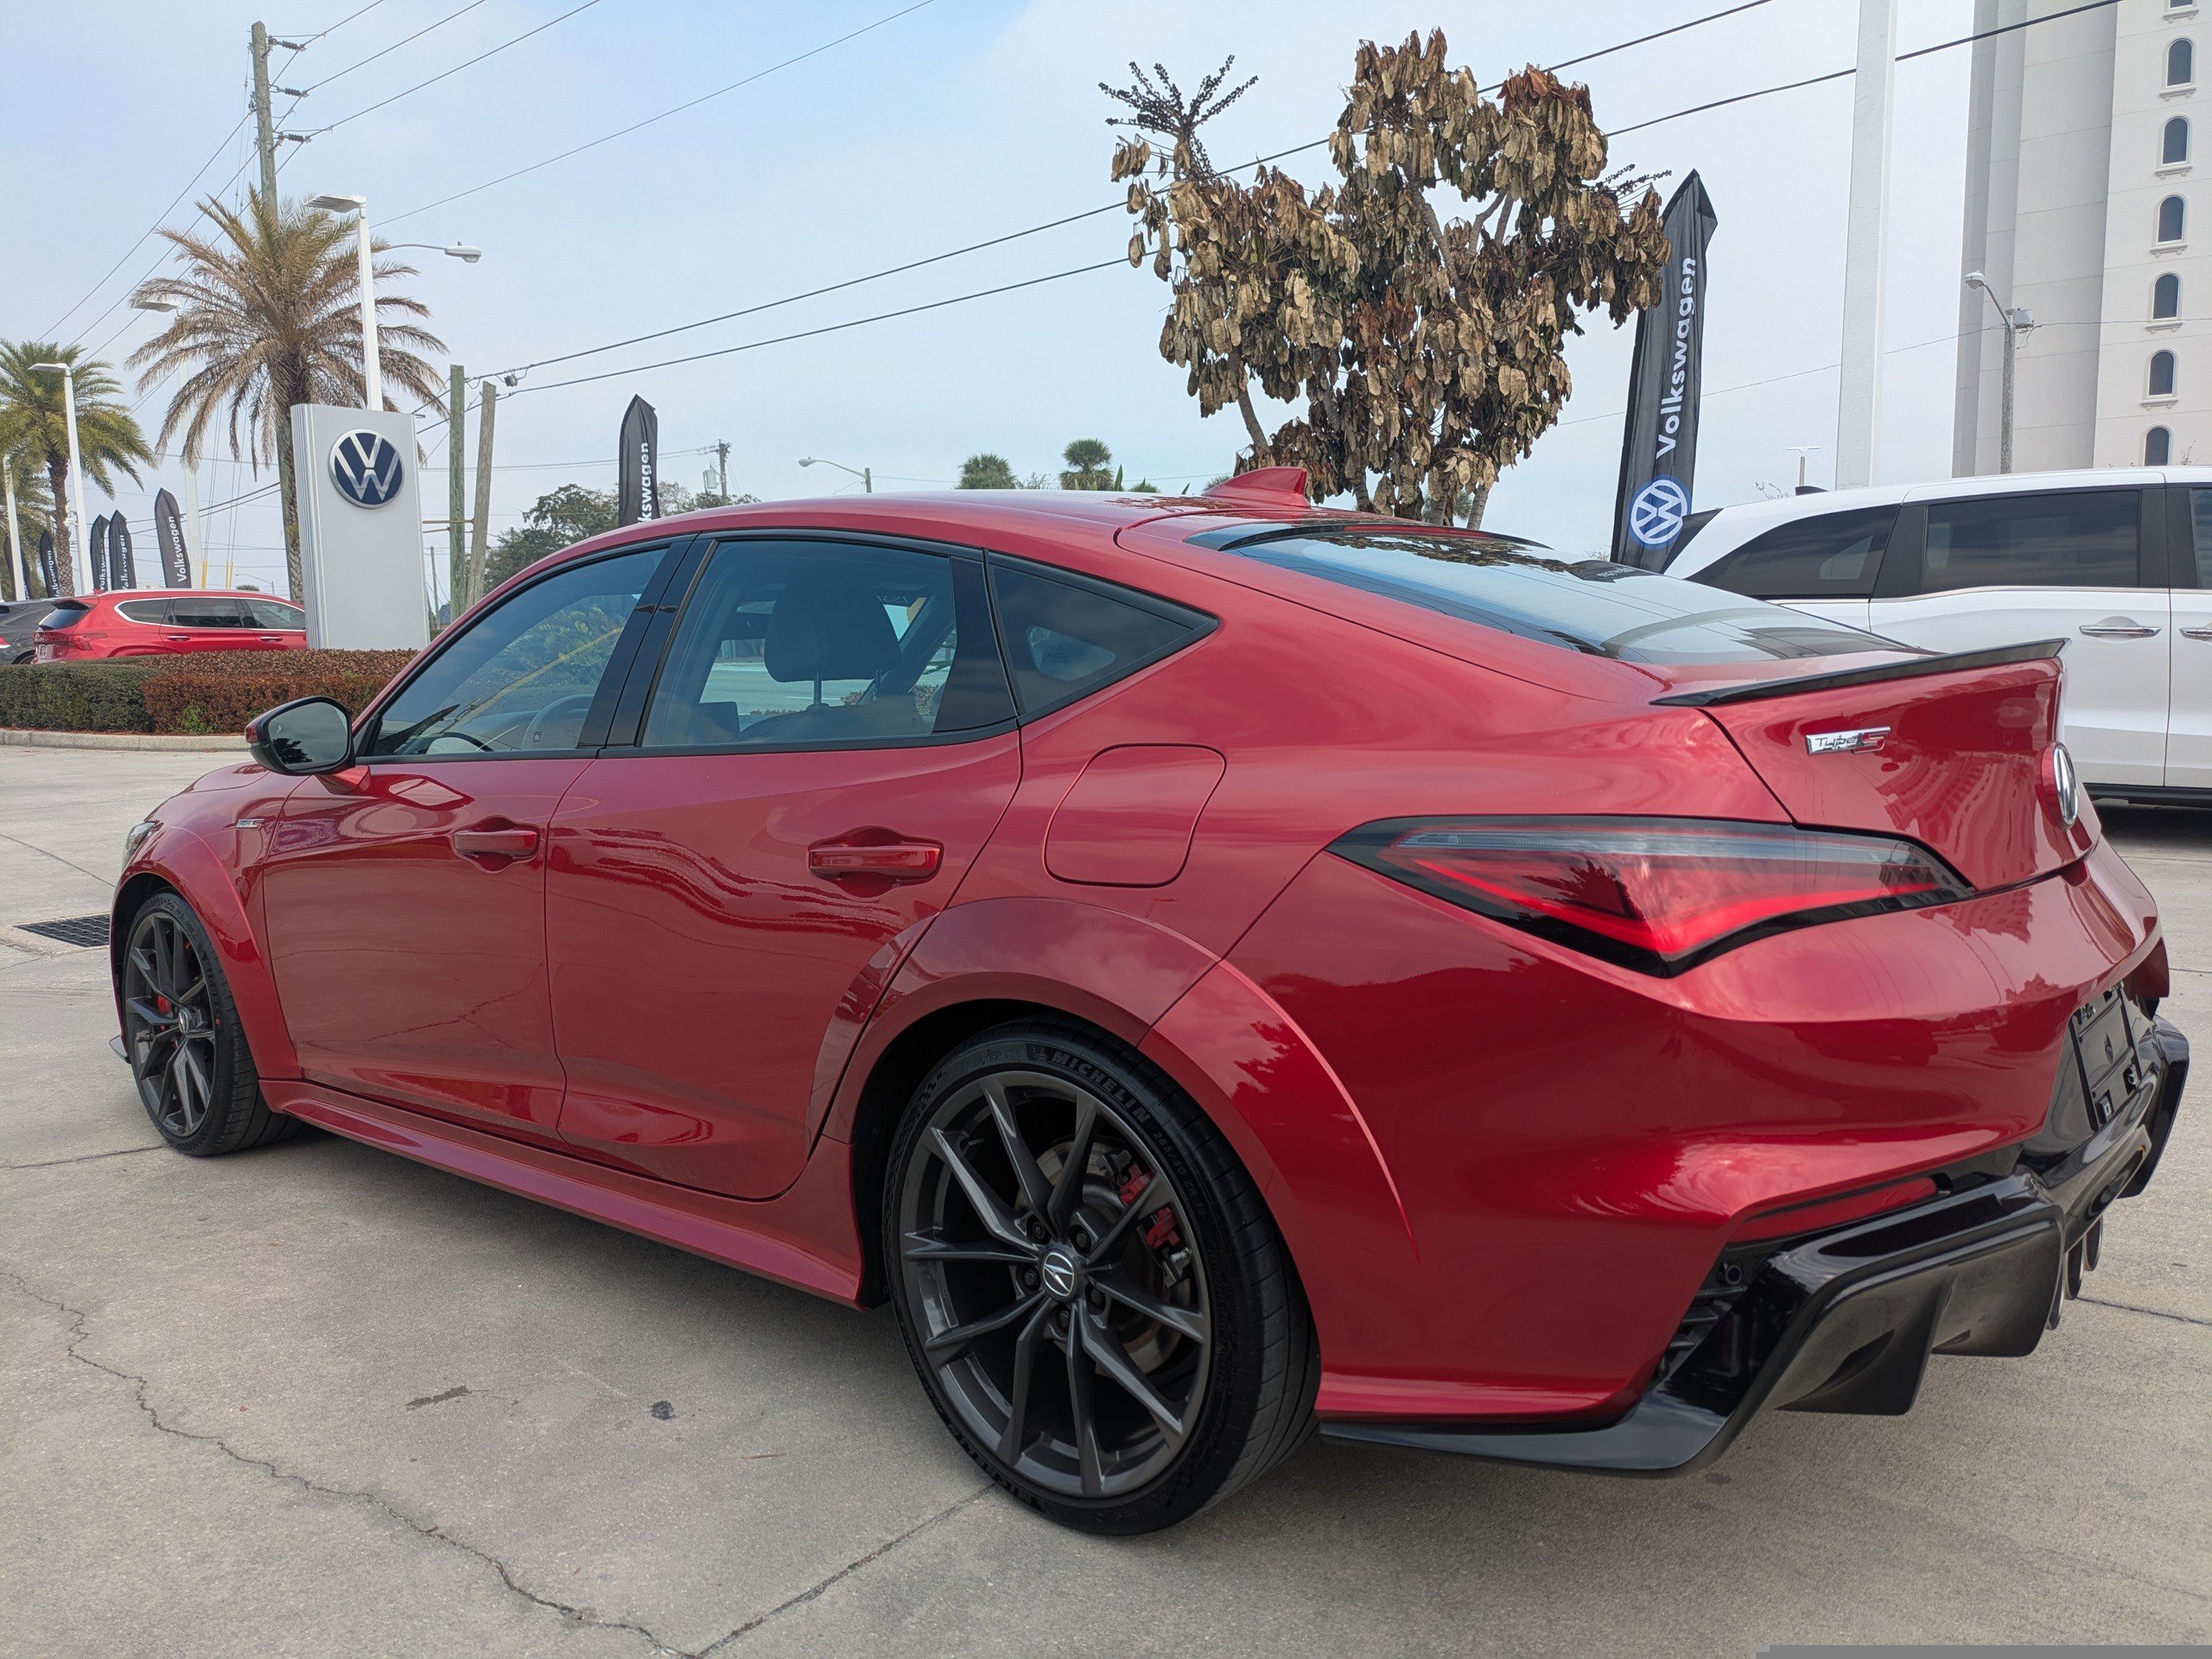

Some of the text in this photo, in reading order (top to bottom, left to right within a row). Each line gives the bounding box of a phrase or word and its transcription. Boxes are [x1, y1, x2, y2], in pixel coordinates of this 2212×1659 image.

[1656, 257, 1696, 459] Volkswagen
[330, 429, 404, 506] VW
[638, 442, 652, 523] kswagen
[168, 516, 188, 582] Volkswagen
[1815, 727, 1891, 753] Type S
[1051, 1050, 1152, 1123] MICHELIN
